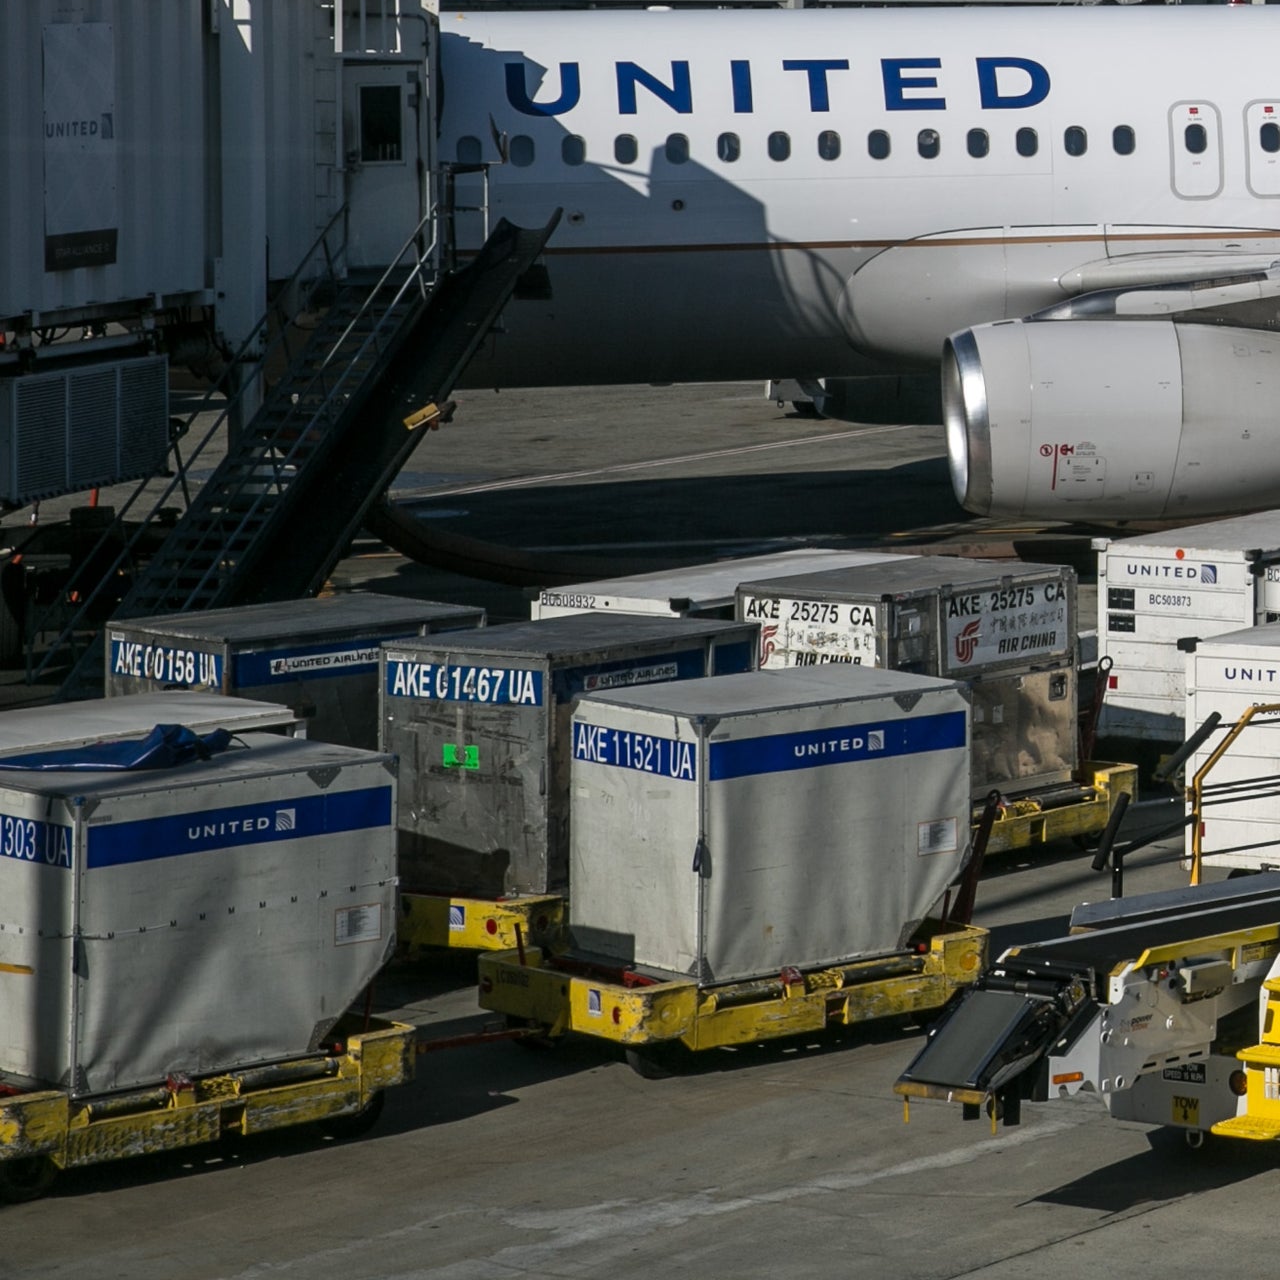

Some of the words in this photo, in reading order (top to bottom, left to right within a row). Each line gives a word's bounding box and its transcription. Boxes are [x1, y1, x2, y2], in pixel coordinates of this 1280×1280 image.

[504, 57, 1051, 117] UNITED
[45, 121, 98, 138] UNITED
[1127, 564, 1197, 579] UNITED
[746, 597, 780, 620] AKE
[790, 601, 839, 624] 25275
[849, 606, 875, 627] CA
[949, 595, 981, 618] AKE
[990, 587, 1035, 612] 25275
[1044, 583, 1066, 602] CA
[1149, 594, 1192, 607] BC503873
[998, 637, 1019, 654] AIR
[1020, 631, 1057, 651] CHINA
[115, 641, 142, 677] AKE
[199, 654, 218, 687] UA
[291, 657, 332, 669] UNITED
[795, 651, 818, 666] AIR
[393, 662, 431, 698] AKE
[509, 670, 536, 705] UA
[576, 723, 608, 763] AKE
[612, 730, 662, 773] 11521
[669, 740, 693, 780] UA
[794, 737, 863, 757] UNITED
[188, 817, 270, 840] UNITED
[45, 823, 70, 867] UA
[1172, 1095, 1199, 1110] TOW
